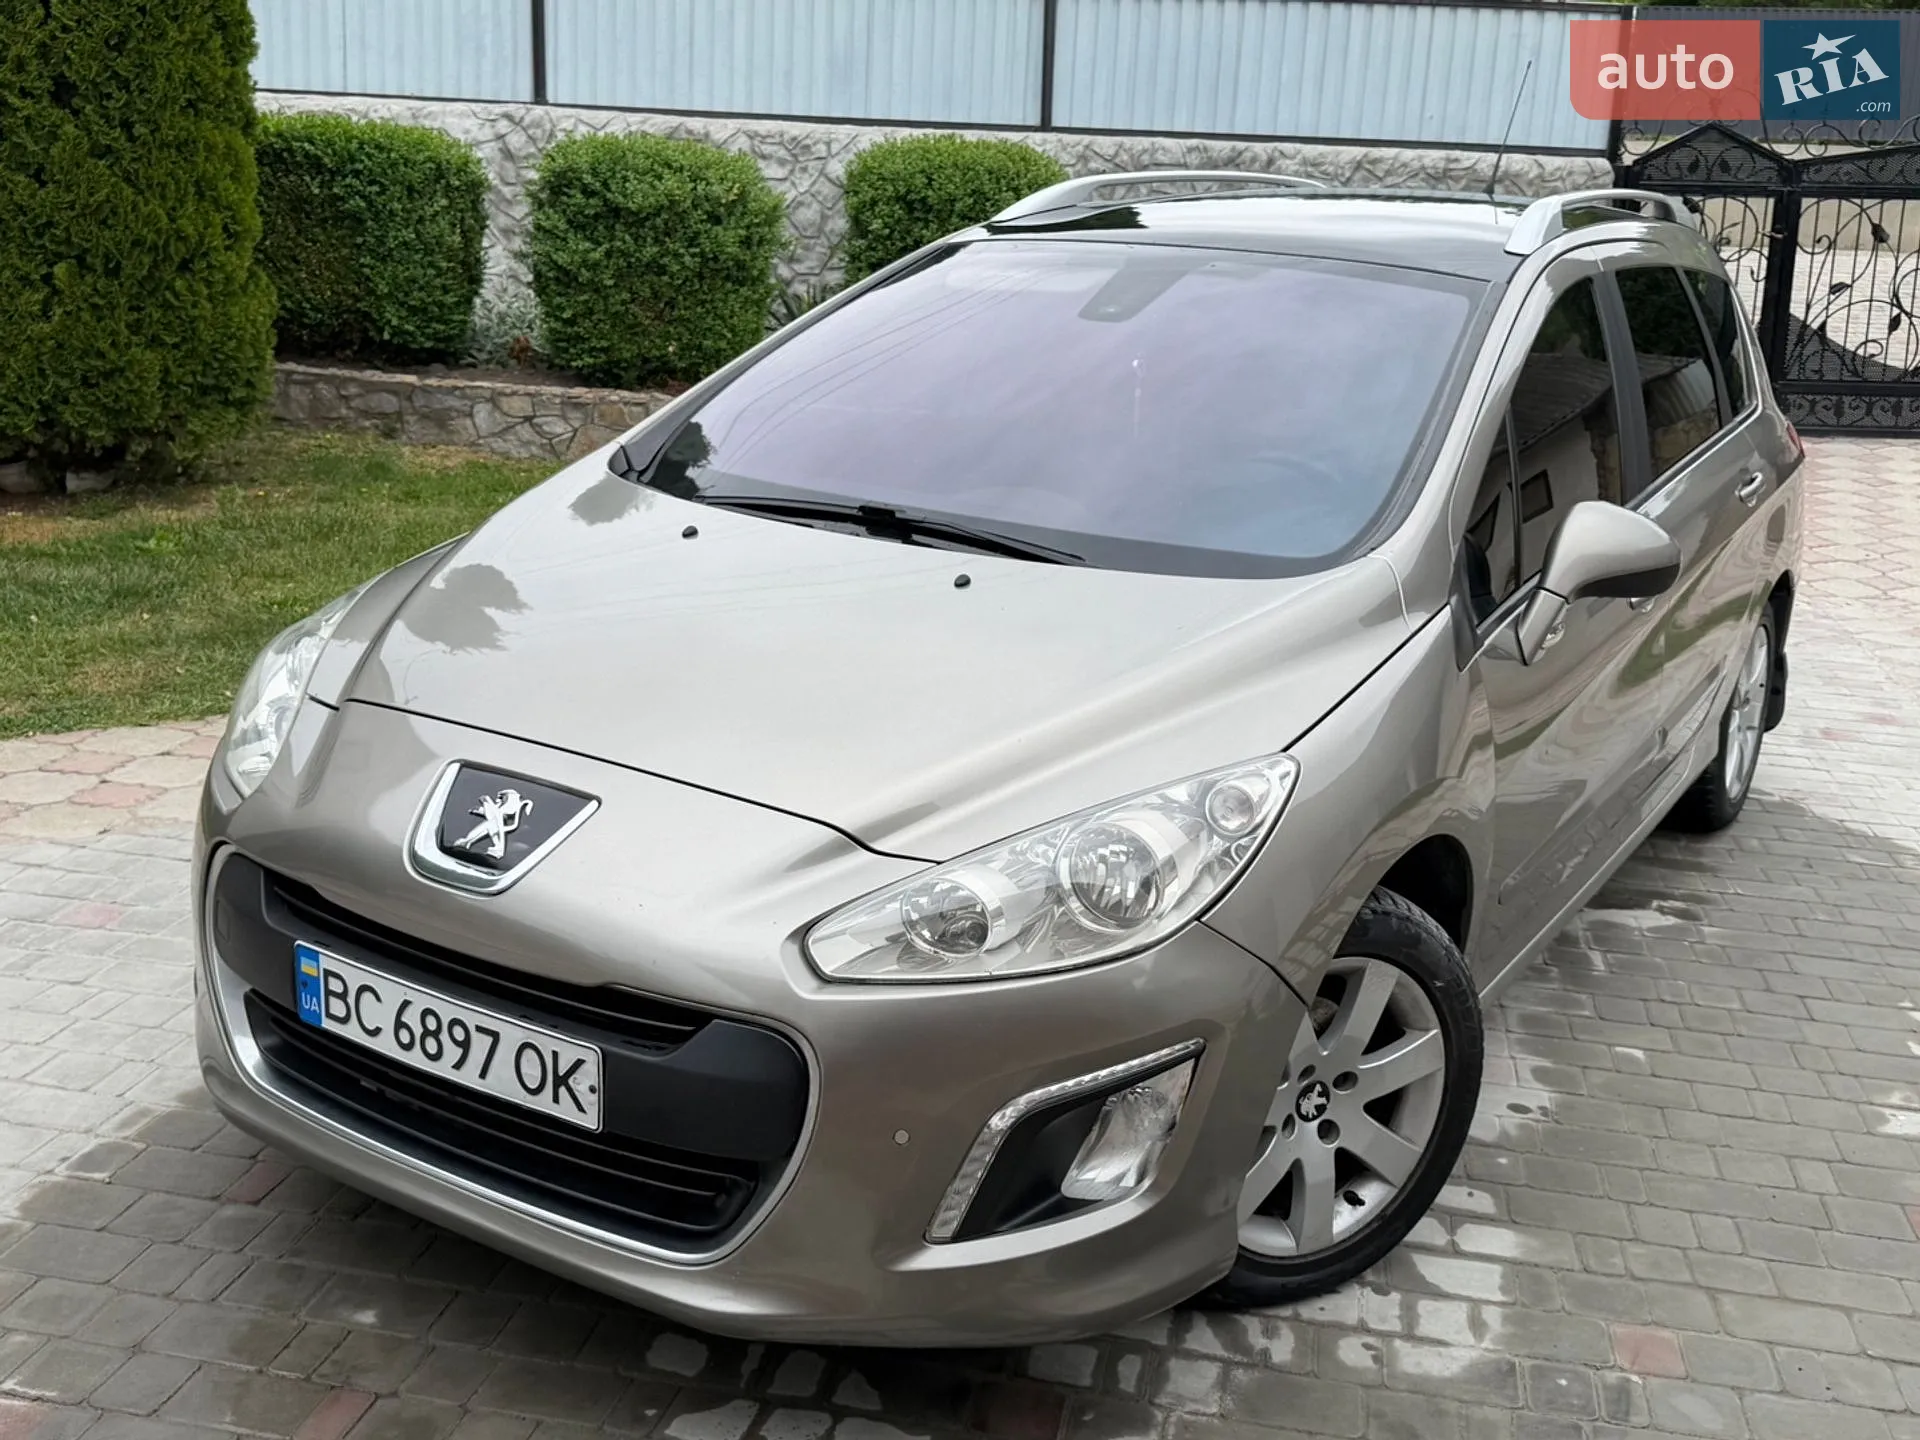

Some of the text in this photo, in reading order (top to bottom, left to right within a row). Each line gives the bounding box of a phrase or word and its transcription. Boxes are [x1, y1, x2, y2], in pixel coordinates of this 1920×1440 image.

[301, 991, 320, 1014] UA
[323, 967, 588, 1115] BC 6897 OK
